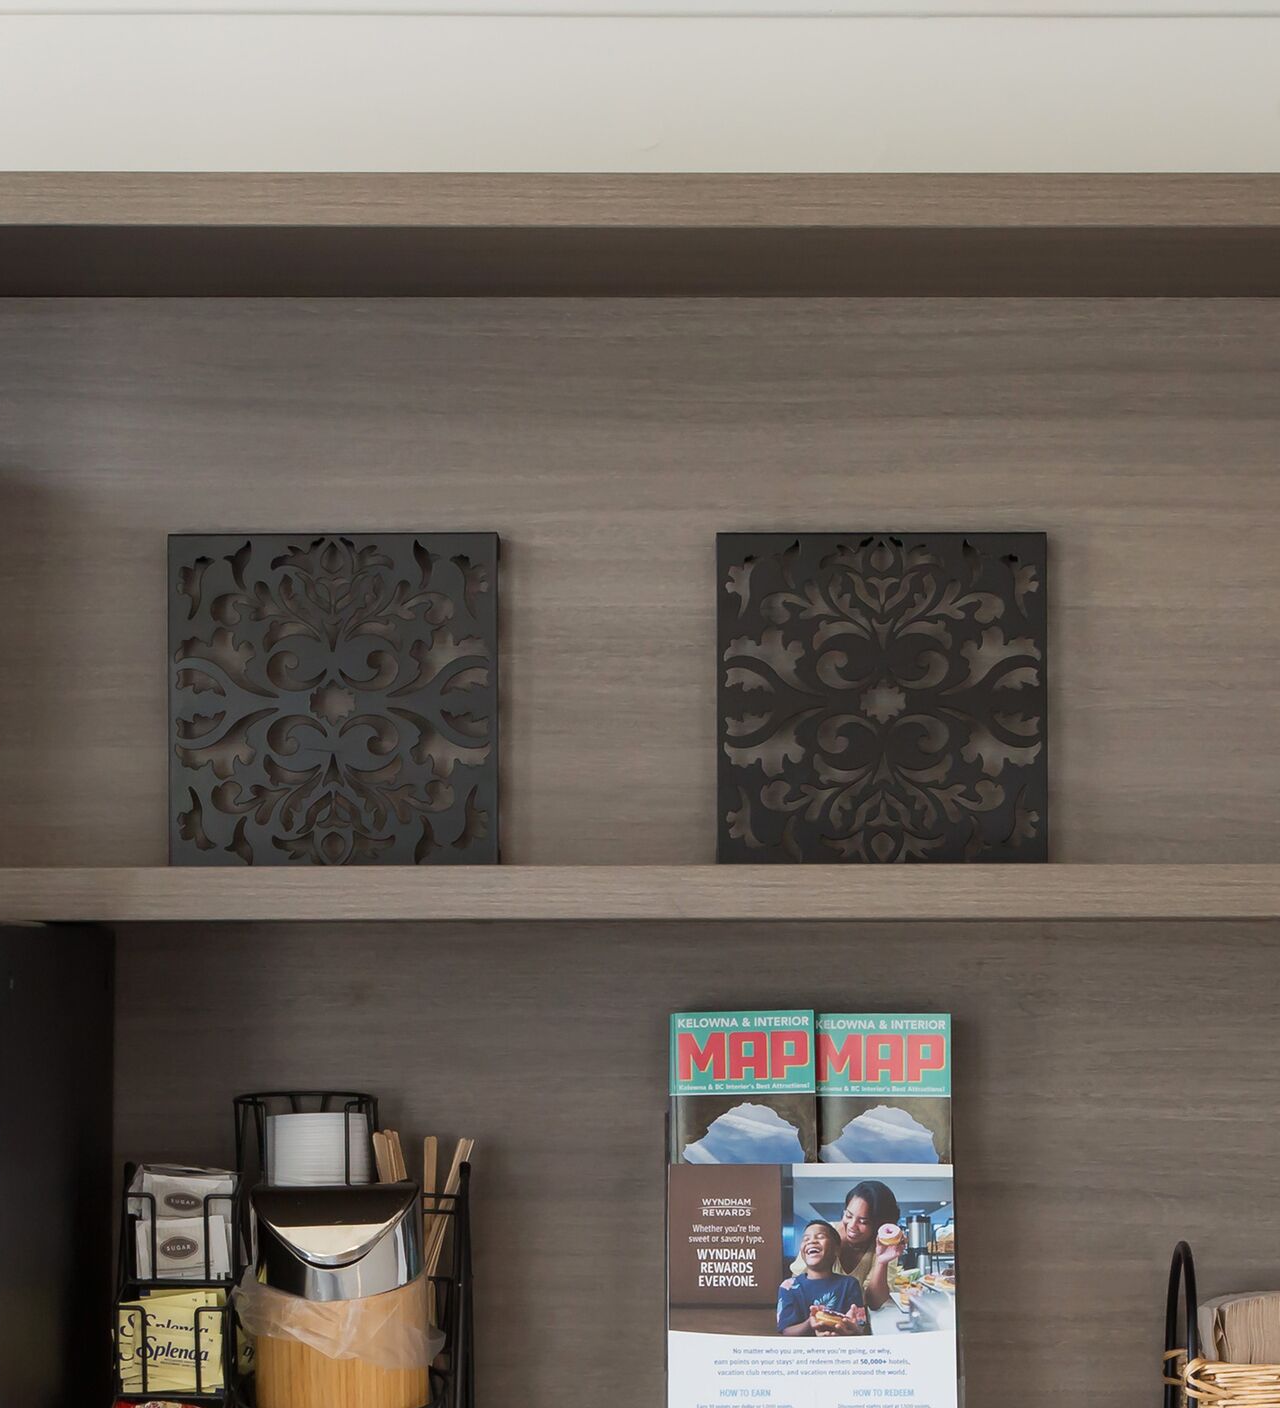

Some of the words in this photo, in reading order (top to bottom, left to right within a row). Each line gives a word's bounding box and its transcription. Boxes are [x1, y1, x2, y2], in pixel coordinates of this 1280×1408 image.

[678, 1018, 739, 1029] KELOWNA
[742, 1018, 751, 1027] &
[754, 1016, 809, 1027] INTERIOR
[816, 1020, 875, 1030] KELOWNA
[879, 1020, 888, 1030] &
[891, 1020, 946, 1030] INTERIOR
[678, 1031, 810, 1081] MAP
[816, 1034, 945, 1083] MAP
[702, 1198, 752, 1206] WYNDHAM
[702, 1209, 752, 1217] REWARDS
[692, 1224, 723, 1233] Whether
[725, 1225, 747, 1234] you're
[748, 1224, 761, 1233] the
[688, 1235, 710, 1243] sweet
[720, 1236, 744, 1244] savory
[697, 1248, 756, 1260] WYNDHAM
[701, 1262, 754, 1273] REWARDS
[698, 1275, 758, 1287] EVERYONE.
[136, 1336, 209, 1361] Splenda
[732, 1348, 740, 1356] No
[742, 1348, 763, 1356] matter
[765, 1348, 778, 1356] who
[780, 1348, 791, 1356] you
[807, 1348, 826, 1356] where
[869, 1348, 876, 1356] or
[714, 1358, 728, 1367] earn
[729, 1358, 749, 1367] points
[751, 1358, 758, 1367] on
[760, 1358, 774, 1367] your
[796, 1358, 807, 1367] and
[809, 1358, 833, 1367] redeem
[835, 1358, 851, 1367] them
[853, 1358, 859, 1367] at
[860, 1358, 887, 1367] 50,000+
[717, 1369, 744, 1377] vacation
[746, 1369, 760, 1377] club
[787, 1369, 799, 1377] and
[800, 1369, 827, 1377] vacation
[828, 1369, 850, 1377] rentals
[852, 1369, 874, 1377] around
[875, 1369, 886, 1377] the
[720, 1389, 738, 1398] HOW
[740, 1389, 750, 1398] TO
[751, 1389, 772, 1398] EARN
[853, 1388, 871, 1397] HOW
[873, 1388, 883, 1397] TO
[884, 1388, 914, 1397] REDEEM
